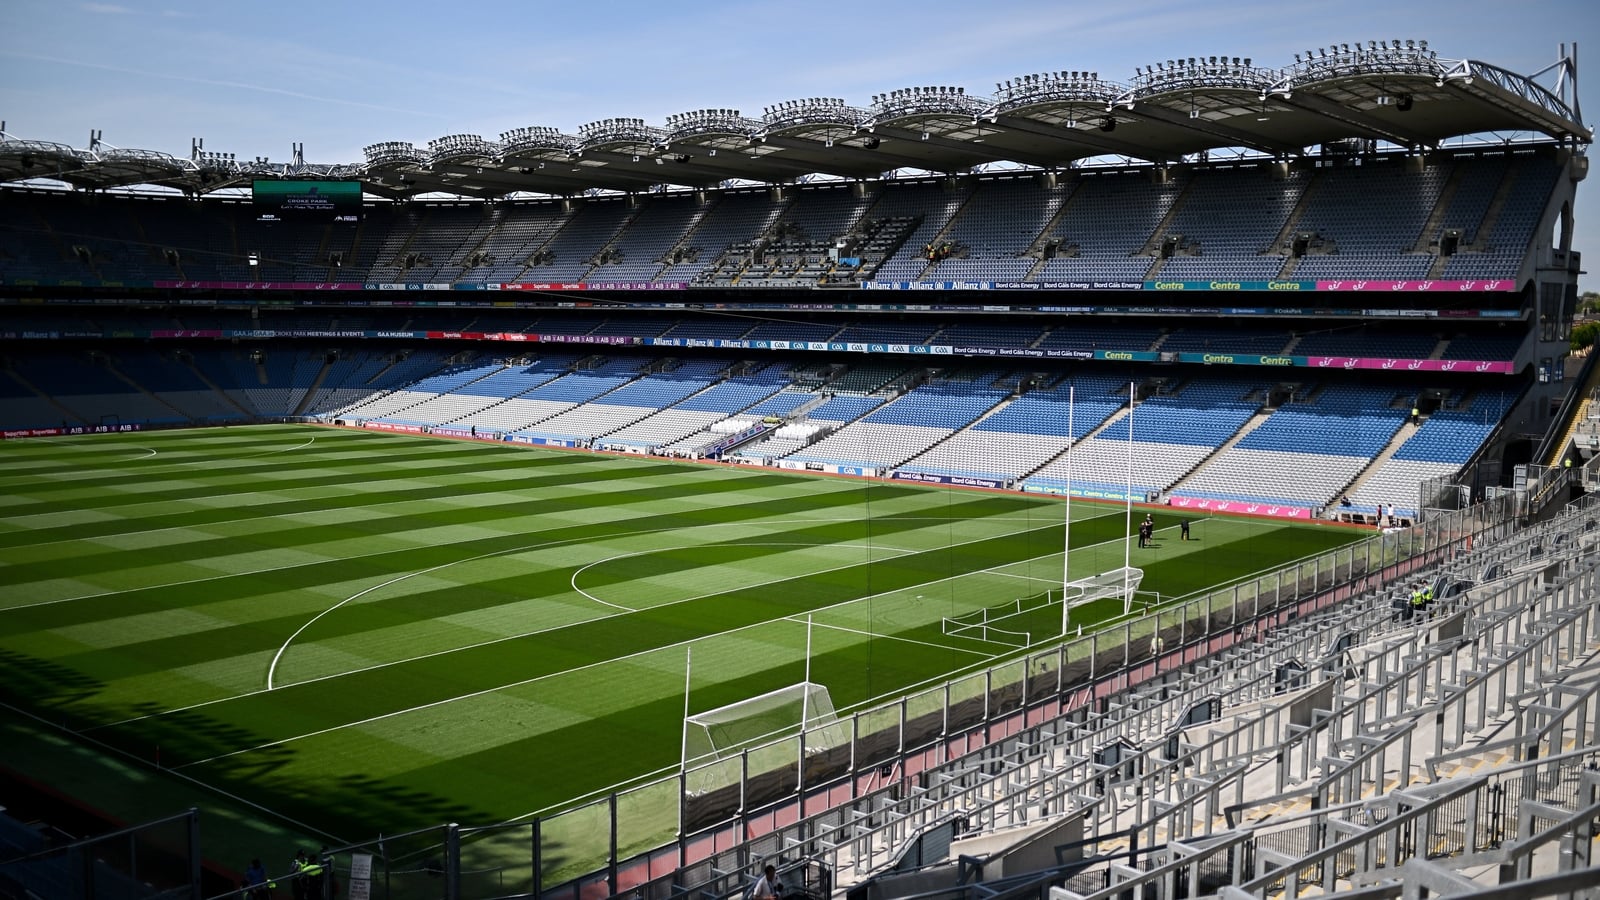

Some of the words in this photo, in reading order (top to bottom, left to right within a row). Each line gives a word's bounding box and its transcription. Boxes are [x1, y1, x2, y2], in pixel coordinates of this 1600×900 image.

[866, 281, 890, 290] Allianz
[908, 281, 933, 290] Allianz
[952, 282, 978, 290] Allianz
[1155, 281, 1184, 290] Centra
[1210, 282, 1240, 290] Centra
[1268, 282, 1300, 290] Centra
[653, 337, 673, 346] Allianz
[686, 338, 707, 347] Allianz
[720, 339, 741, 348] Allianz
[1025, 349, 1044, 357] Energy
[1073, 351, 1094, 359] Energy
[1105, 351, 1132, 360] Centra
[1203, 353, 1234, 364] Centra
[976, 479, 996, 488] Energy
